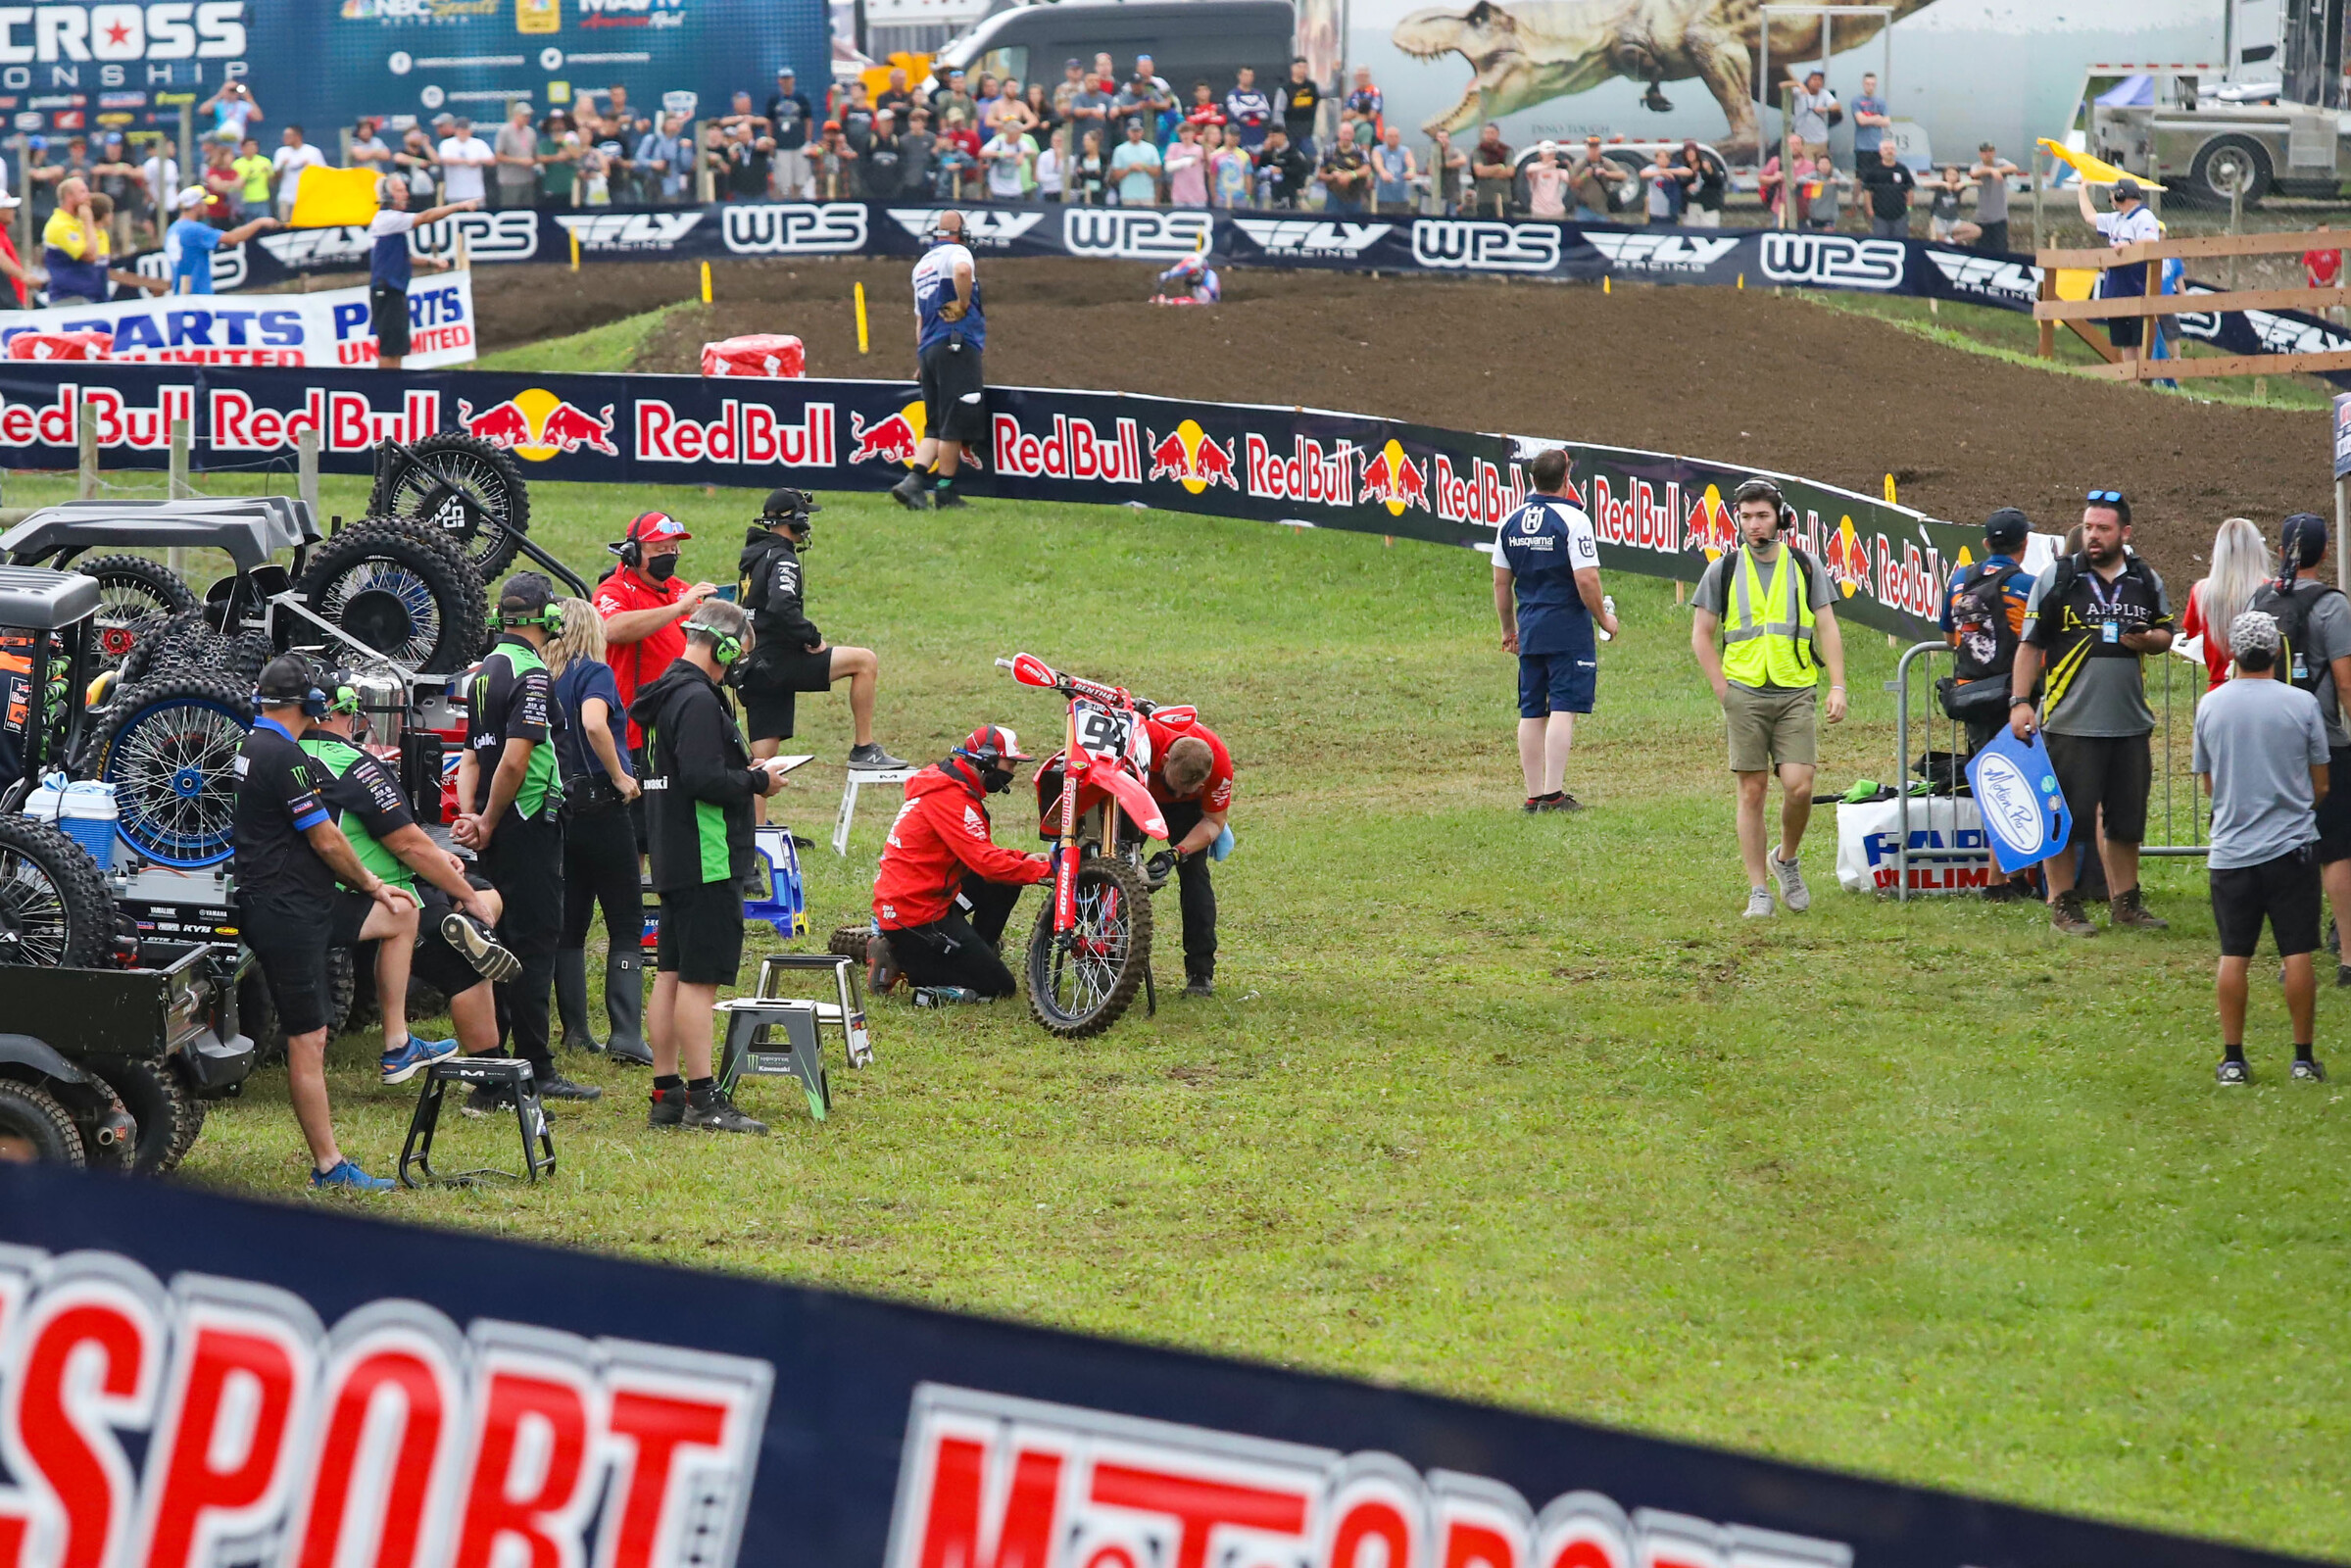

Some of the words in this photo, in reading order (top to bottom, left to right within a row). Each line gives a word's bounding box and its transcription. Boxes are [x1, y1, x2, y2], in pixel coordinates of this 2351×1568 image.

[0, 2, 246, 63] CROSS
[405, 210, 537, 261] WPS
[554, 212, 703, 241] FLY
[722, 203, 867, 254] WPS
[1063, 208, 1213, 260] WPS
[1232, 218, 1393, 249] FLY
[1413, 220, 1560, 272] WPS
[1265, 246, 1358, 260] RACING
[1581, 230, 1739, 265] FLY
[1614, 260, 1707, 274] RACING
[1760, 232, 1906, 290] WPS
[333, 286, 463, 341] PRTS
[1508, 535, 1555, 548] Husqvarna
[1074, 683, 1118, 702] RENTHAL
[97, 740, 111, 781] UNLOP
[1057, 860, 1071, 916] DUNLOP
[183, 924, 212, 934] KYB
